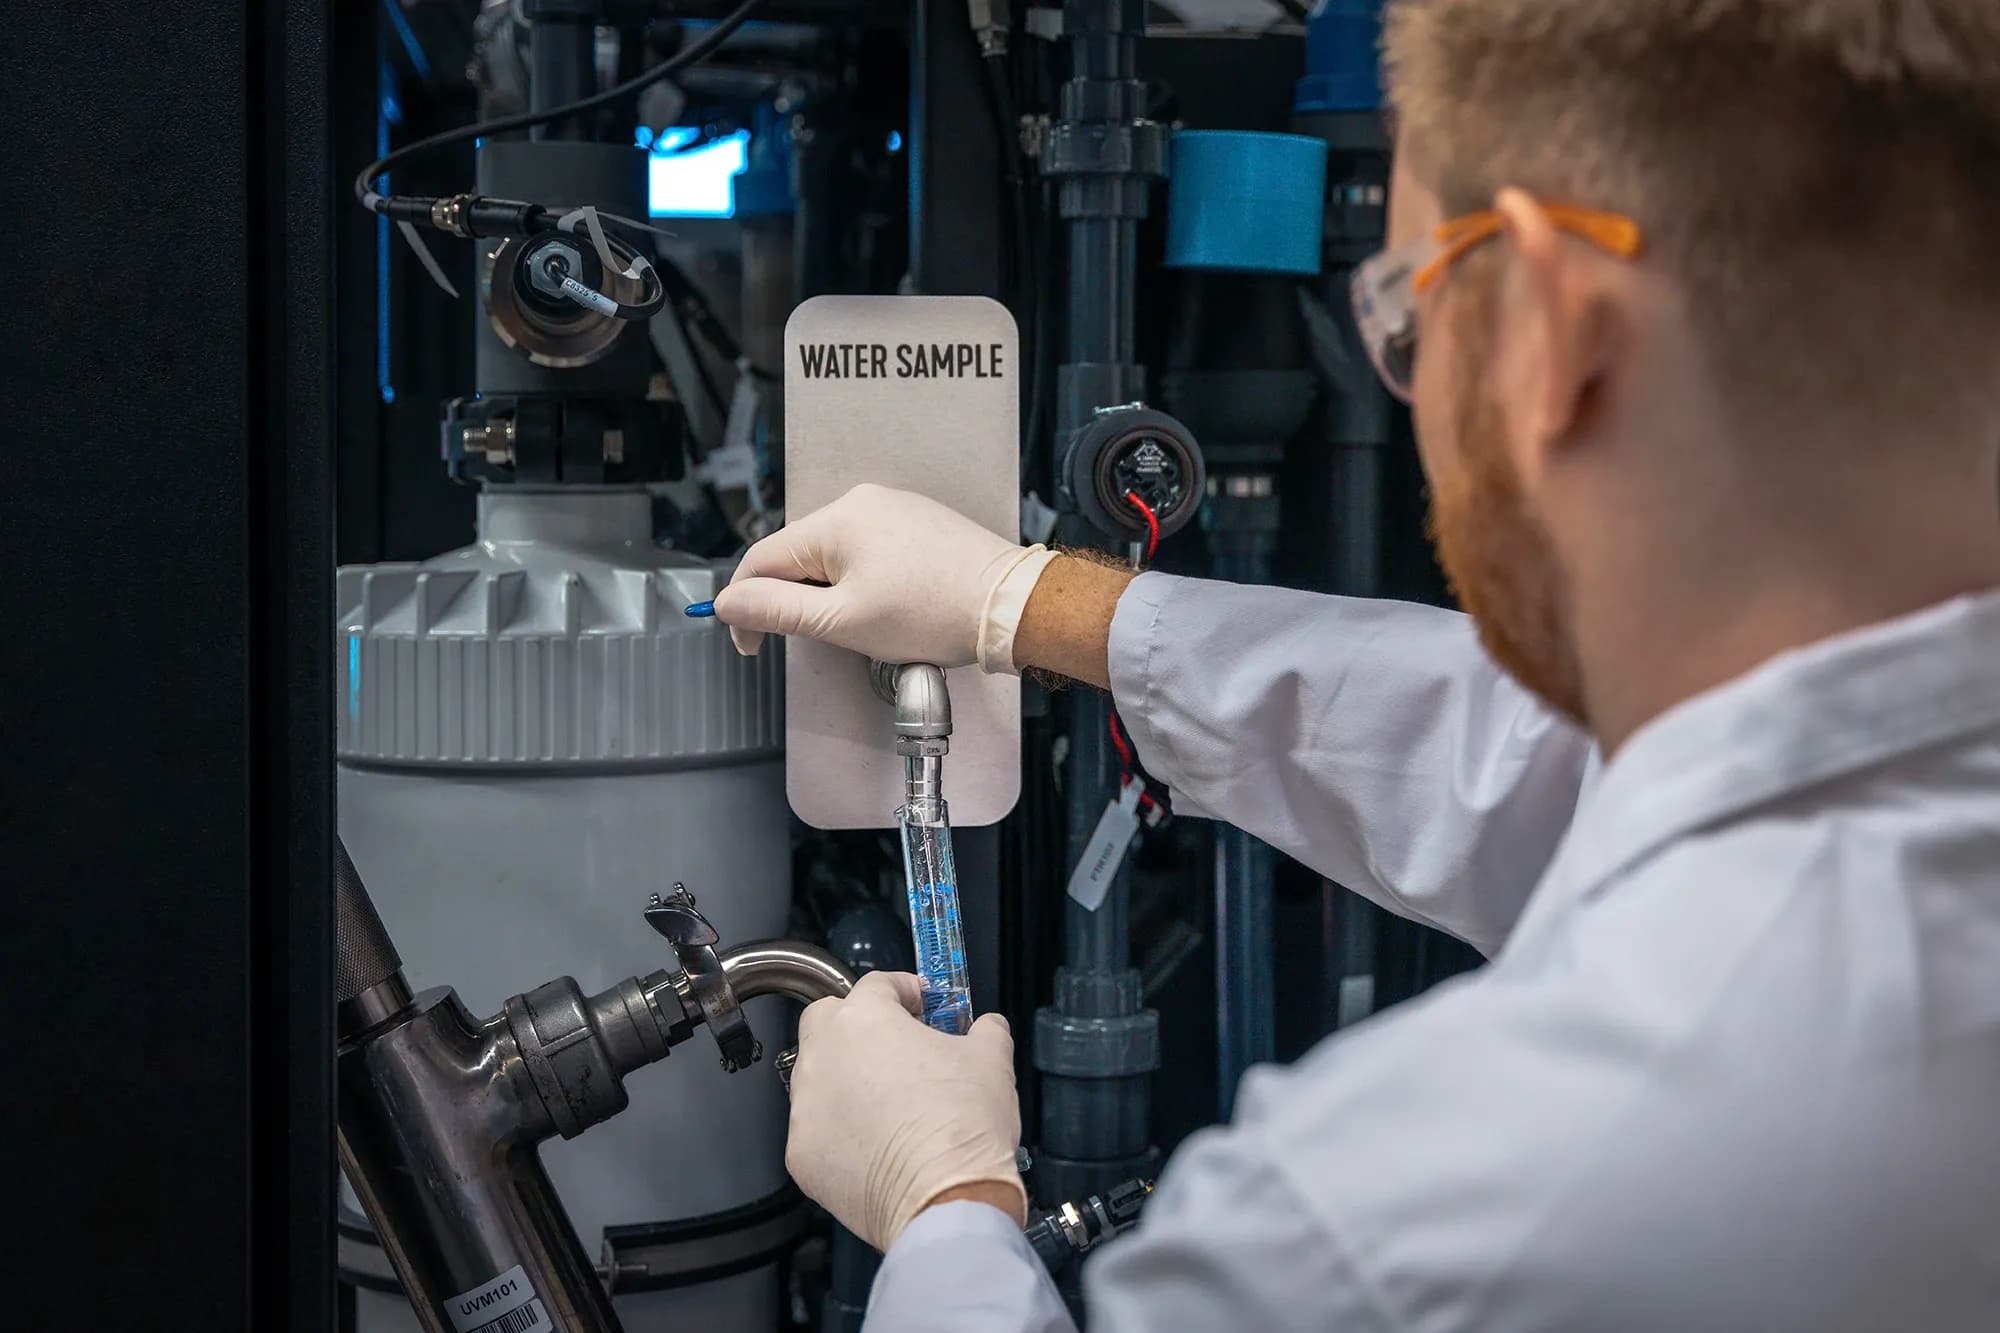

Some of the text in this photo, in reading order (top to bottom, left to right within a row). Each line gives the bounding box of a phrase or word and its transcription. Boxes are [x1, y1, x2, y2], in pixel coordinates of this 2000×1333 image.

[799, 344, 1003, 378] WATER SAMPLE
[460, 1279, 518, 1316] UVM101
